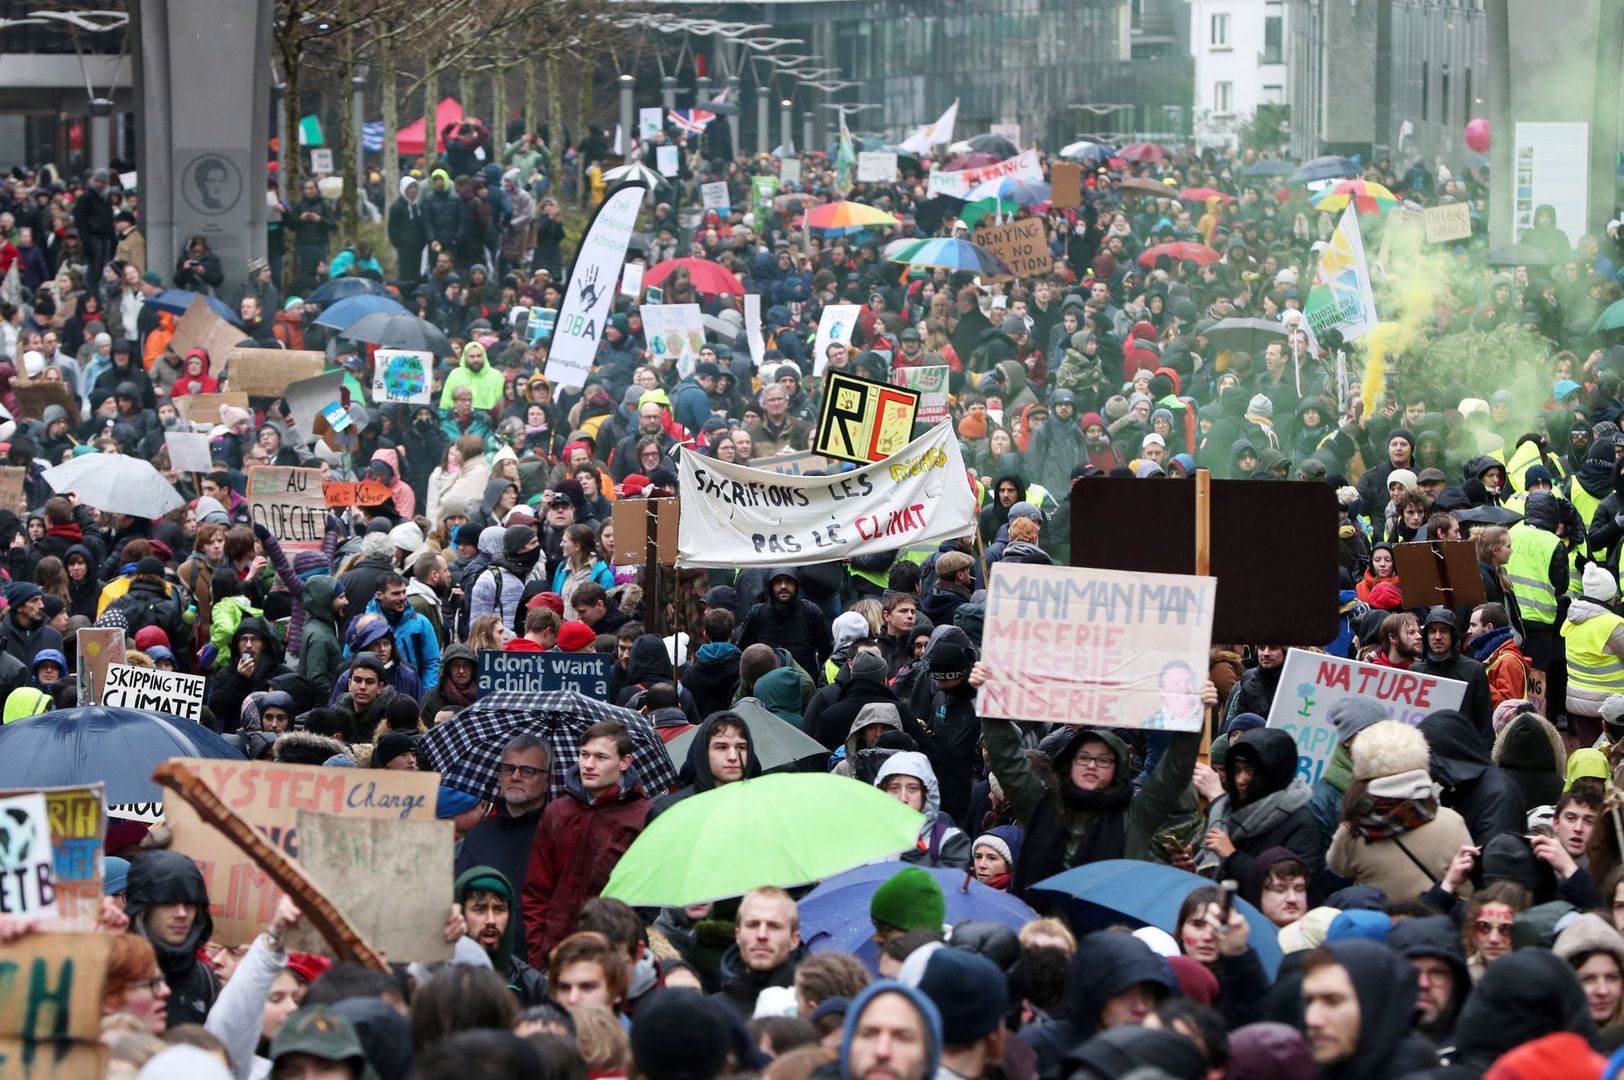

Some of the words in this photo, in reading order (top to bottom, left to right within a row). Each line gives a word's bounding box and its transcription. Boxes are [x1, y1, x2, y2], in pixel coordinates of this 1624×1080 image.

[932, 174, 957, 187] THE
[977, 223, 1038, 246] DENYING
[1013, 244, 1032, 256] NO
[1011, 256, 1047, 272] TION
[286, 469, 307, 492] AU
[829, 473, 873, 502] LES
[271, 503, 330, 541] DECHET
[752, 533, 802, 553] PAS
[855, 504, 928, 542] CLIMAT
[484, 653, 490, 671] I
[494, 653, 545, 673] don't
[552, 659, 604, 676] want
[107, 666, 172, 692] SKIPPING
[175, 677, 204, 698] THE
[479, 674, 491, 689] a
[494, 673, 543, 692] child
[560, 676, 581, 694] in
[594, 680, 607, 695] a
[1316, 661, 1437, 709] NATURE
[189, 765, 345, 813] YSTEM
[347, 782, 425, 819] Change
